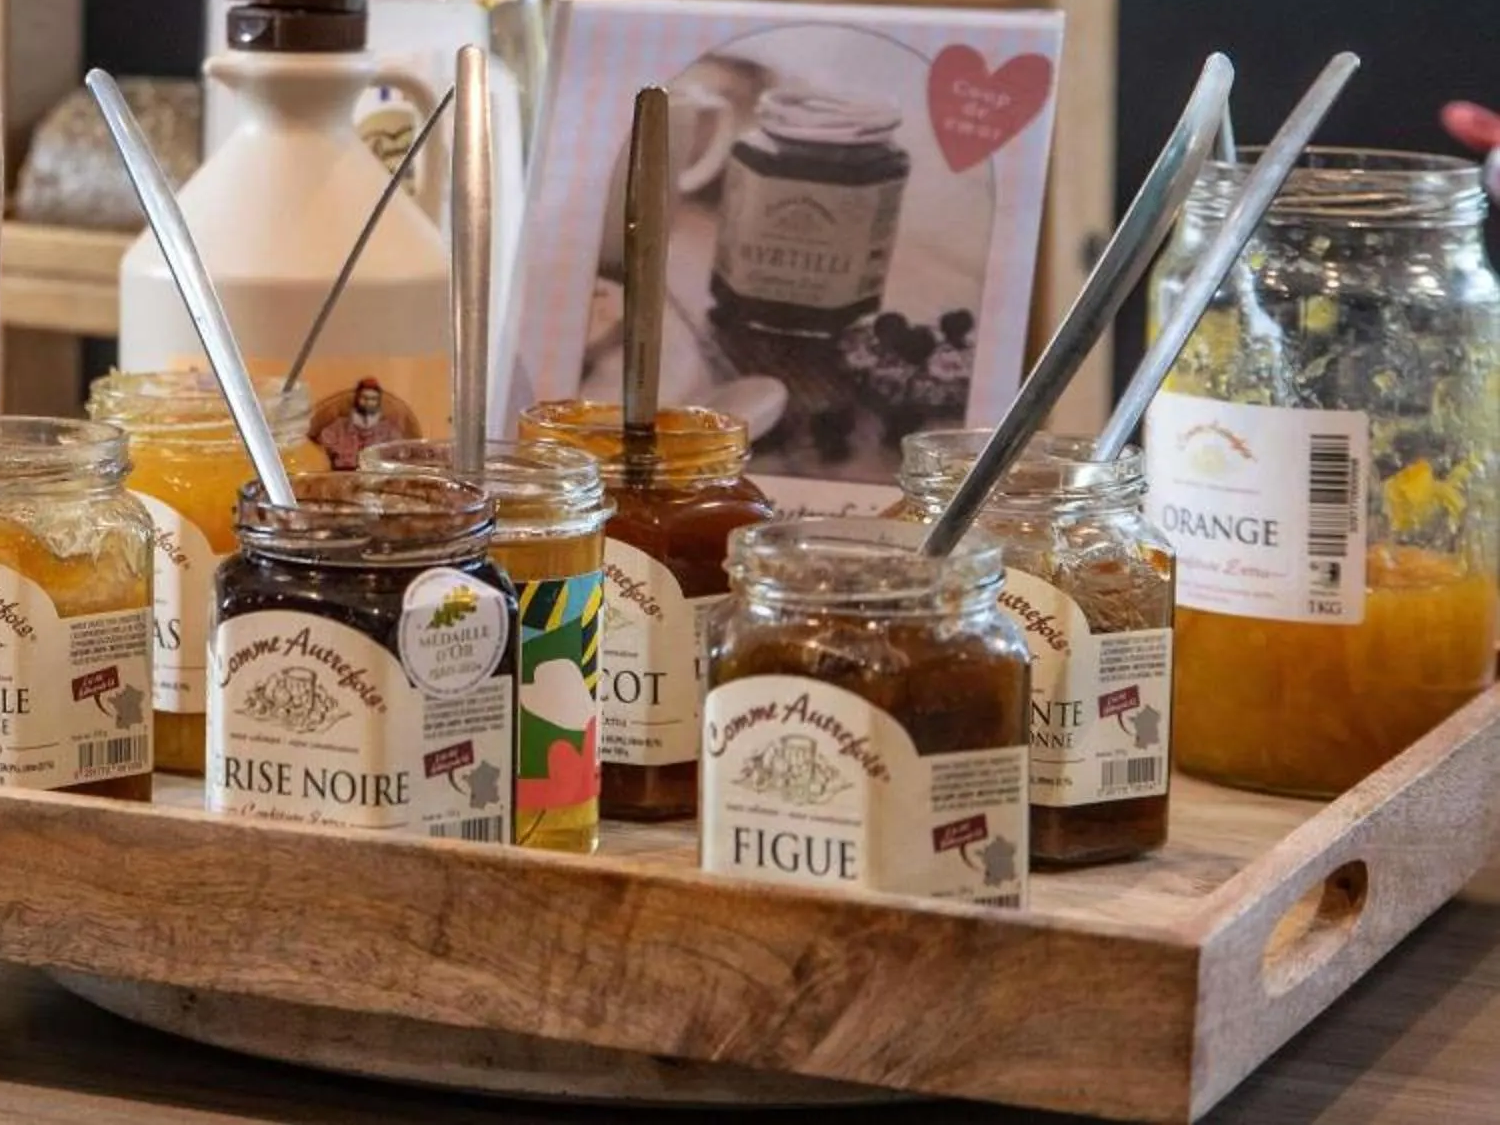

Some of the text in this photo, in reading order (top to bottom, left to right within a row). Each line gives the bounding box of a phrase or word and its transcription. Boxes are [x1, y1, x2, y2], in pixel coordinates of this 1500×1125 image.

[1161, 504, 1280, 548] ORANGE
[997, 590, 1069, 653] utrefois
[285, 627, 384, 708] Autrefois
[706, 693, 887, 780] Comme Autrefois
[223, 757, 411, 808] RISE NOIRE
[732, 826, 858, 881] FIGUE
